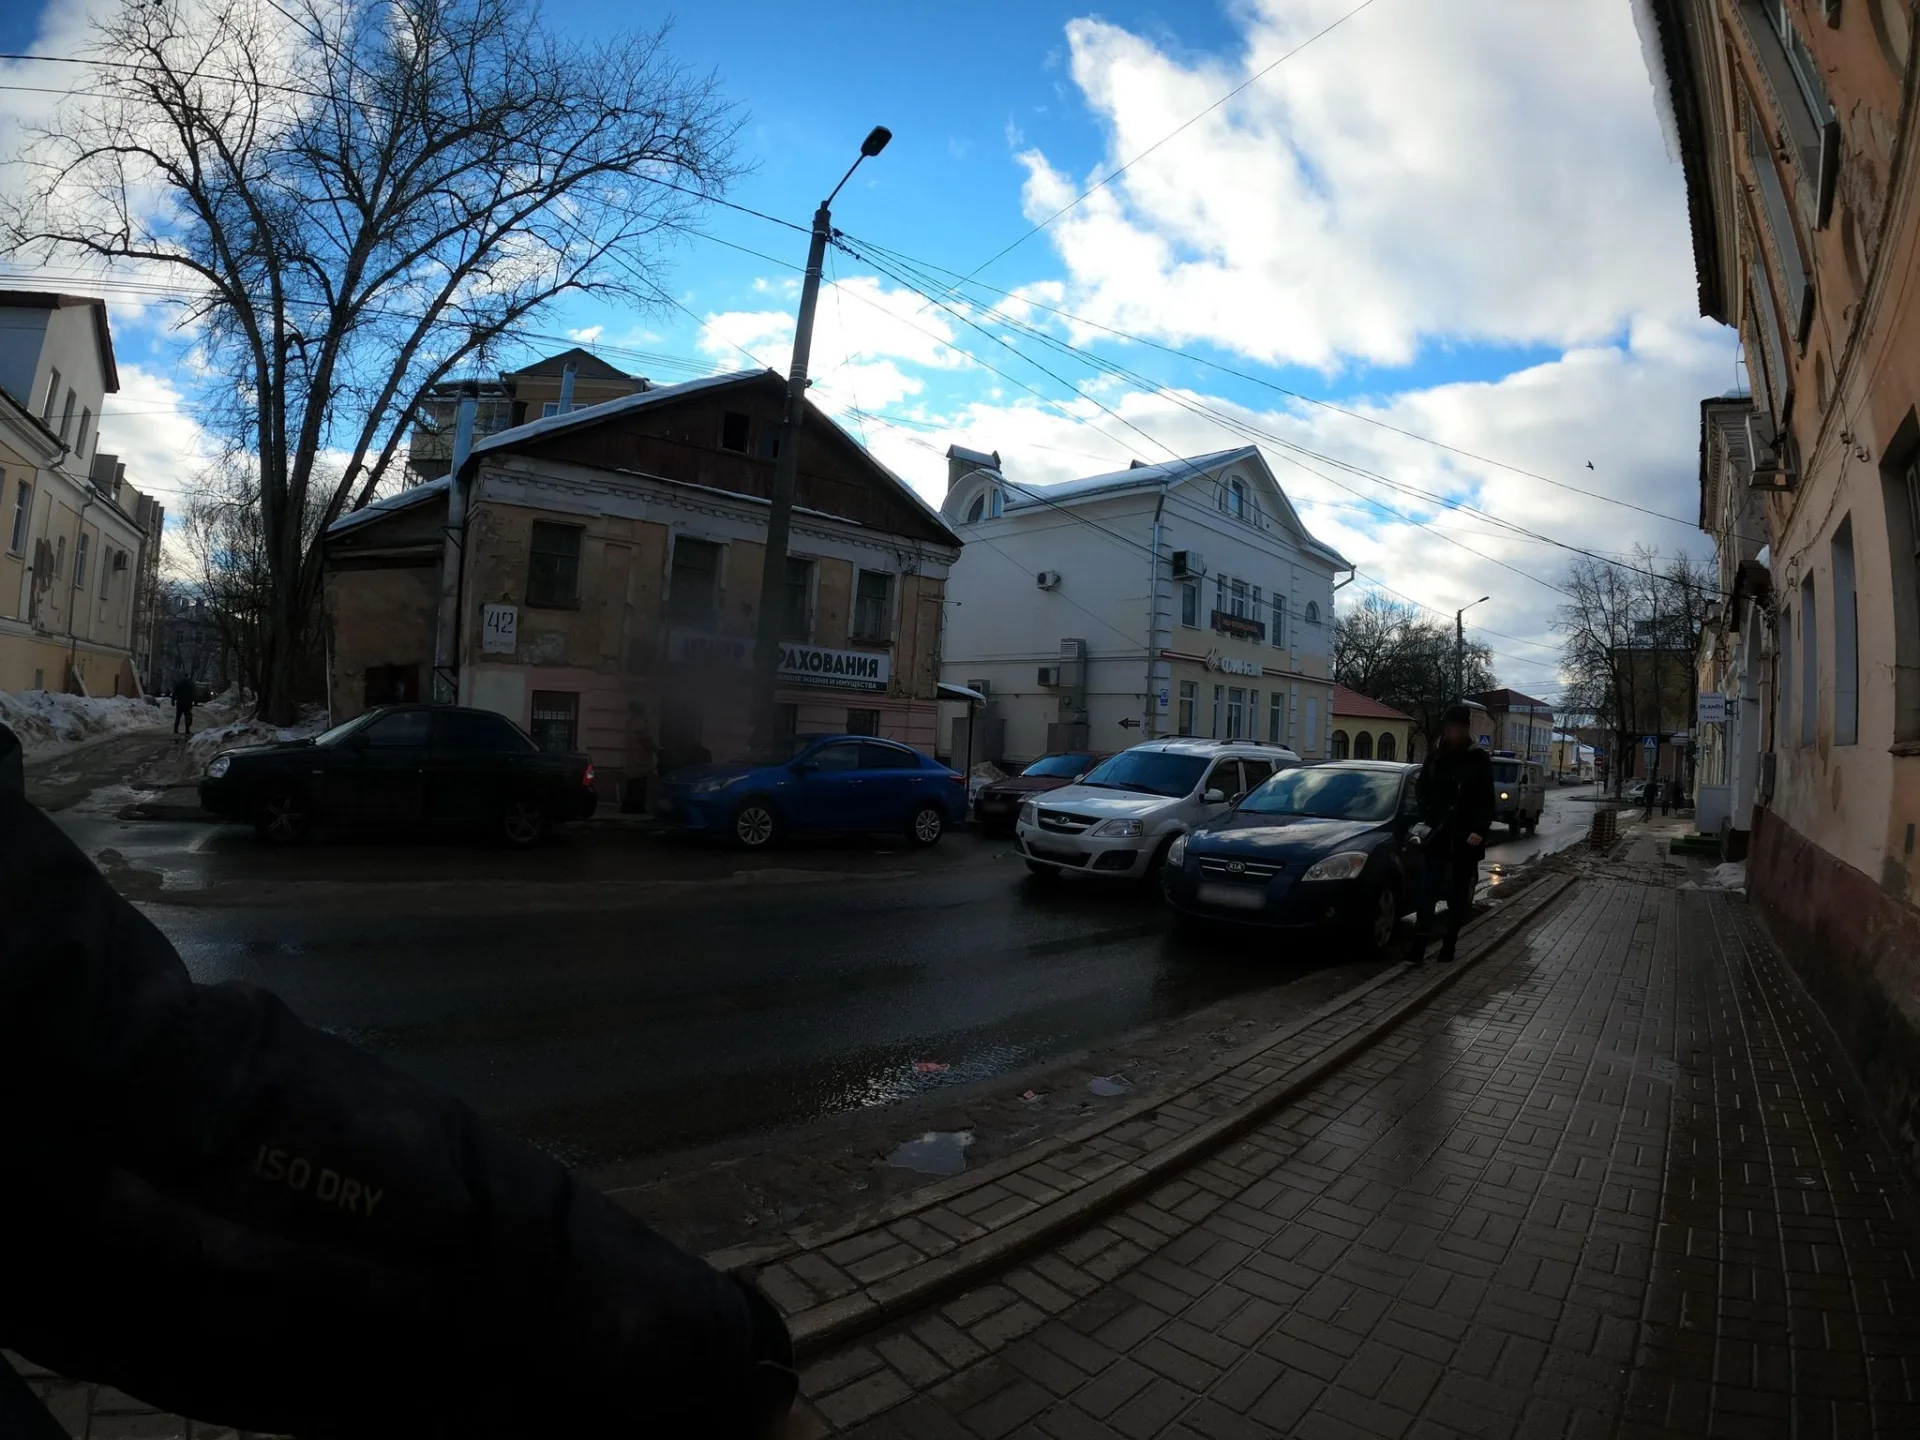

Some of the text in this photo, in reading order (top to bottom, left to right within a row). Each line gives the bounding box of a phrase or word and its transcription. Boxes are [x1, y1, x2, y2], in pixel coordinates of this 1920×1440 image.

[487, 612, 513, 633] 42
[836, 679, 877, 689] ИМУЩЕСТВА
[1228, 862, 1243, 871] KIA
[253, 1142, 384, 1219] ISO DRY
